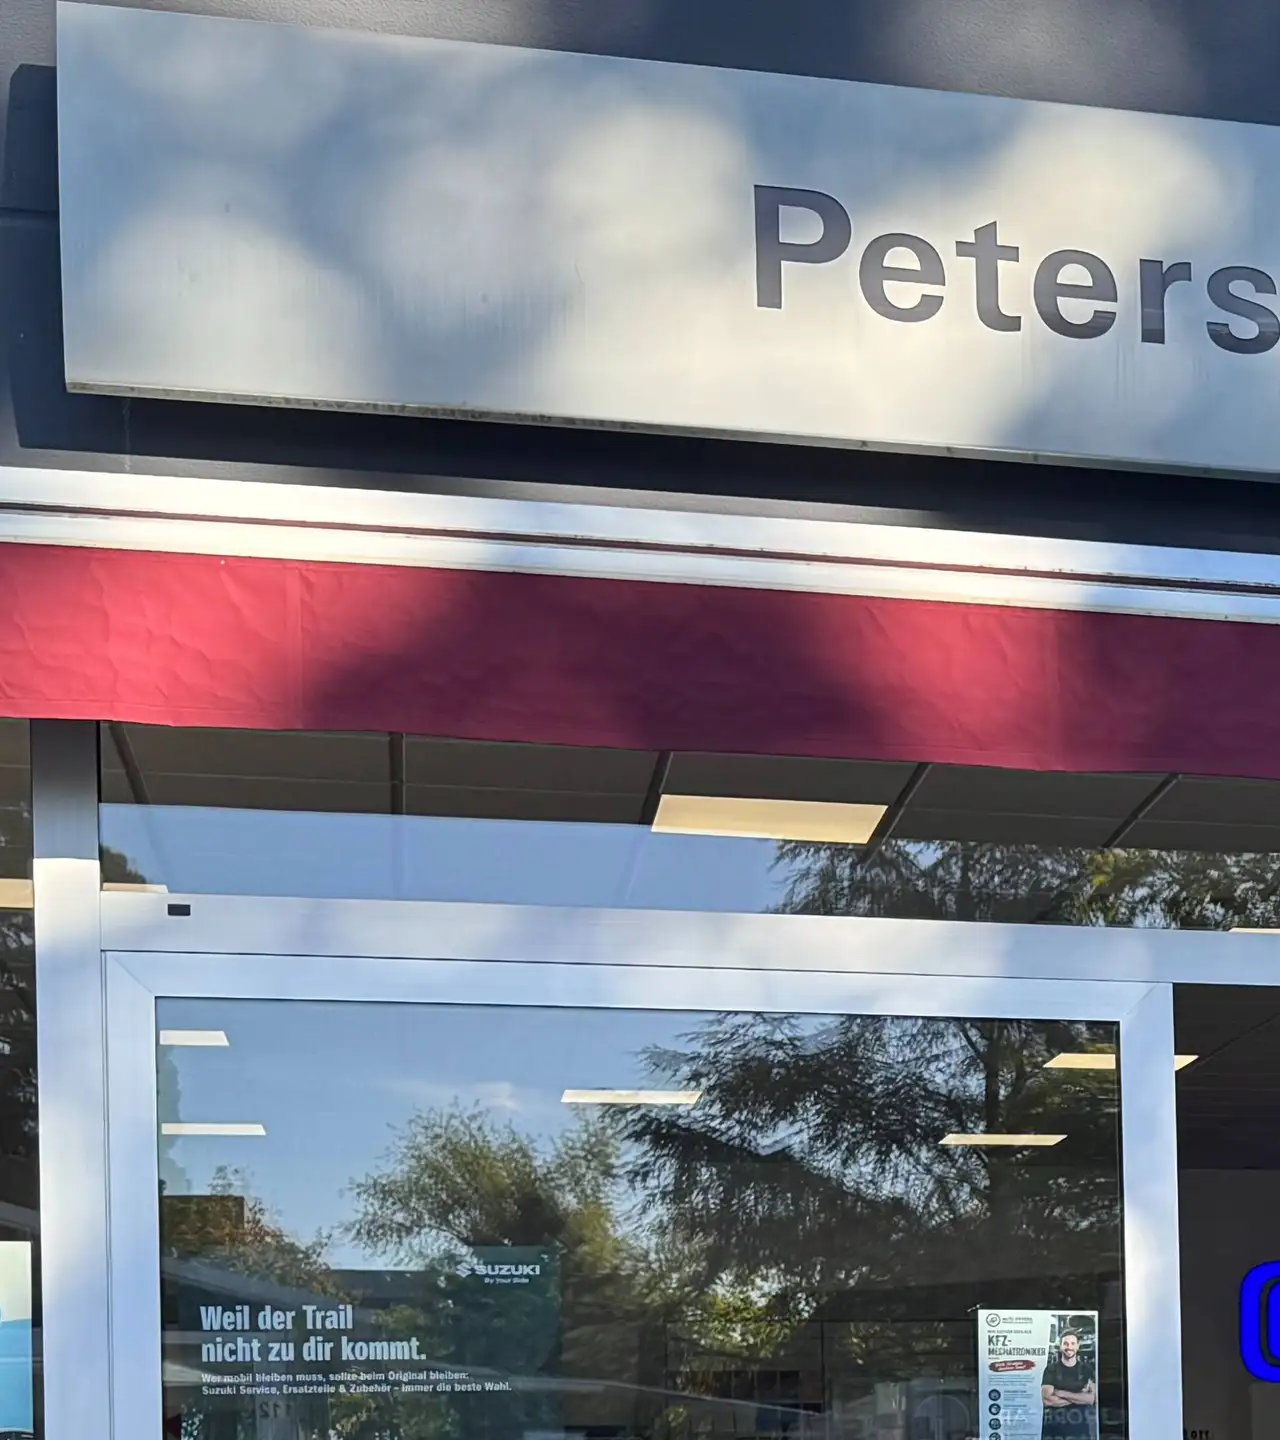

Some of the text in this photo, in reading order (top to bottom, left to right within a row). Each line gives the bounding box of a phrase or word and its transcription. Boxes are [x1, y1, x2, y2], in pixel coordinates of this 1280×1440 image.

[753, 184, 1280, 355] Peters
[474, 1264, 540, 1276] SUZUKI
[200, 1304, 354, 1331] Weil der Trail
[987, 1335, 1012, 1347] KFZ-
[201, 1336, 427, 1363] nicht zu dir kommt.
[201, 1374, 220, 1383] Wer
[256, 1372, 293, 1382] bleiben
[296, 1373, 326, 1382] muss,
[388, 1371, 427, 1382] Original
[430, 1371, 469, 1381] bleiben:
[201, 1385, 236, 1395] Suzuki
[239, 1385, 280, 1396] Service,
[282, 1384, 336, 1394] Ersatzteile
[350, 1383, 392, 1393] Zubehör
[402, 1384, 434, 1392] immer
[436, 1383, 452, 1392] die
[455, 1382, 482, 1392] beste
[484, 1382, 512, 1391] Wahl.
